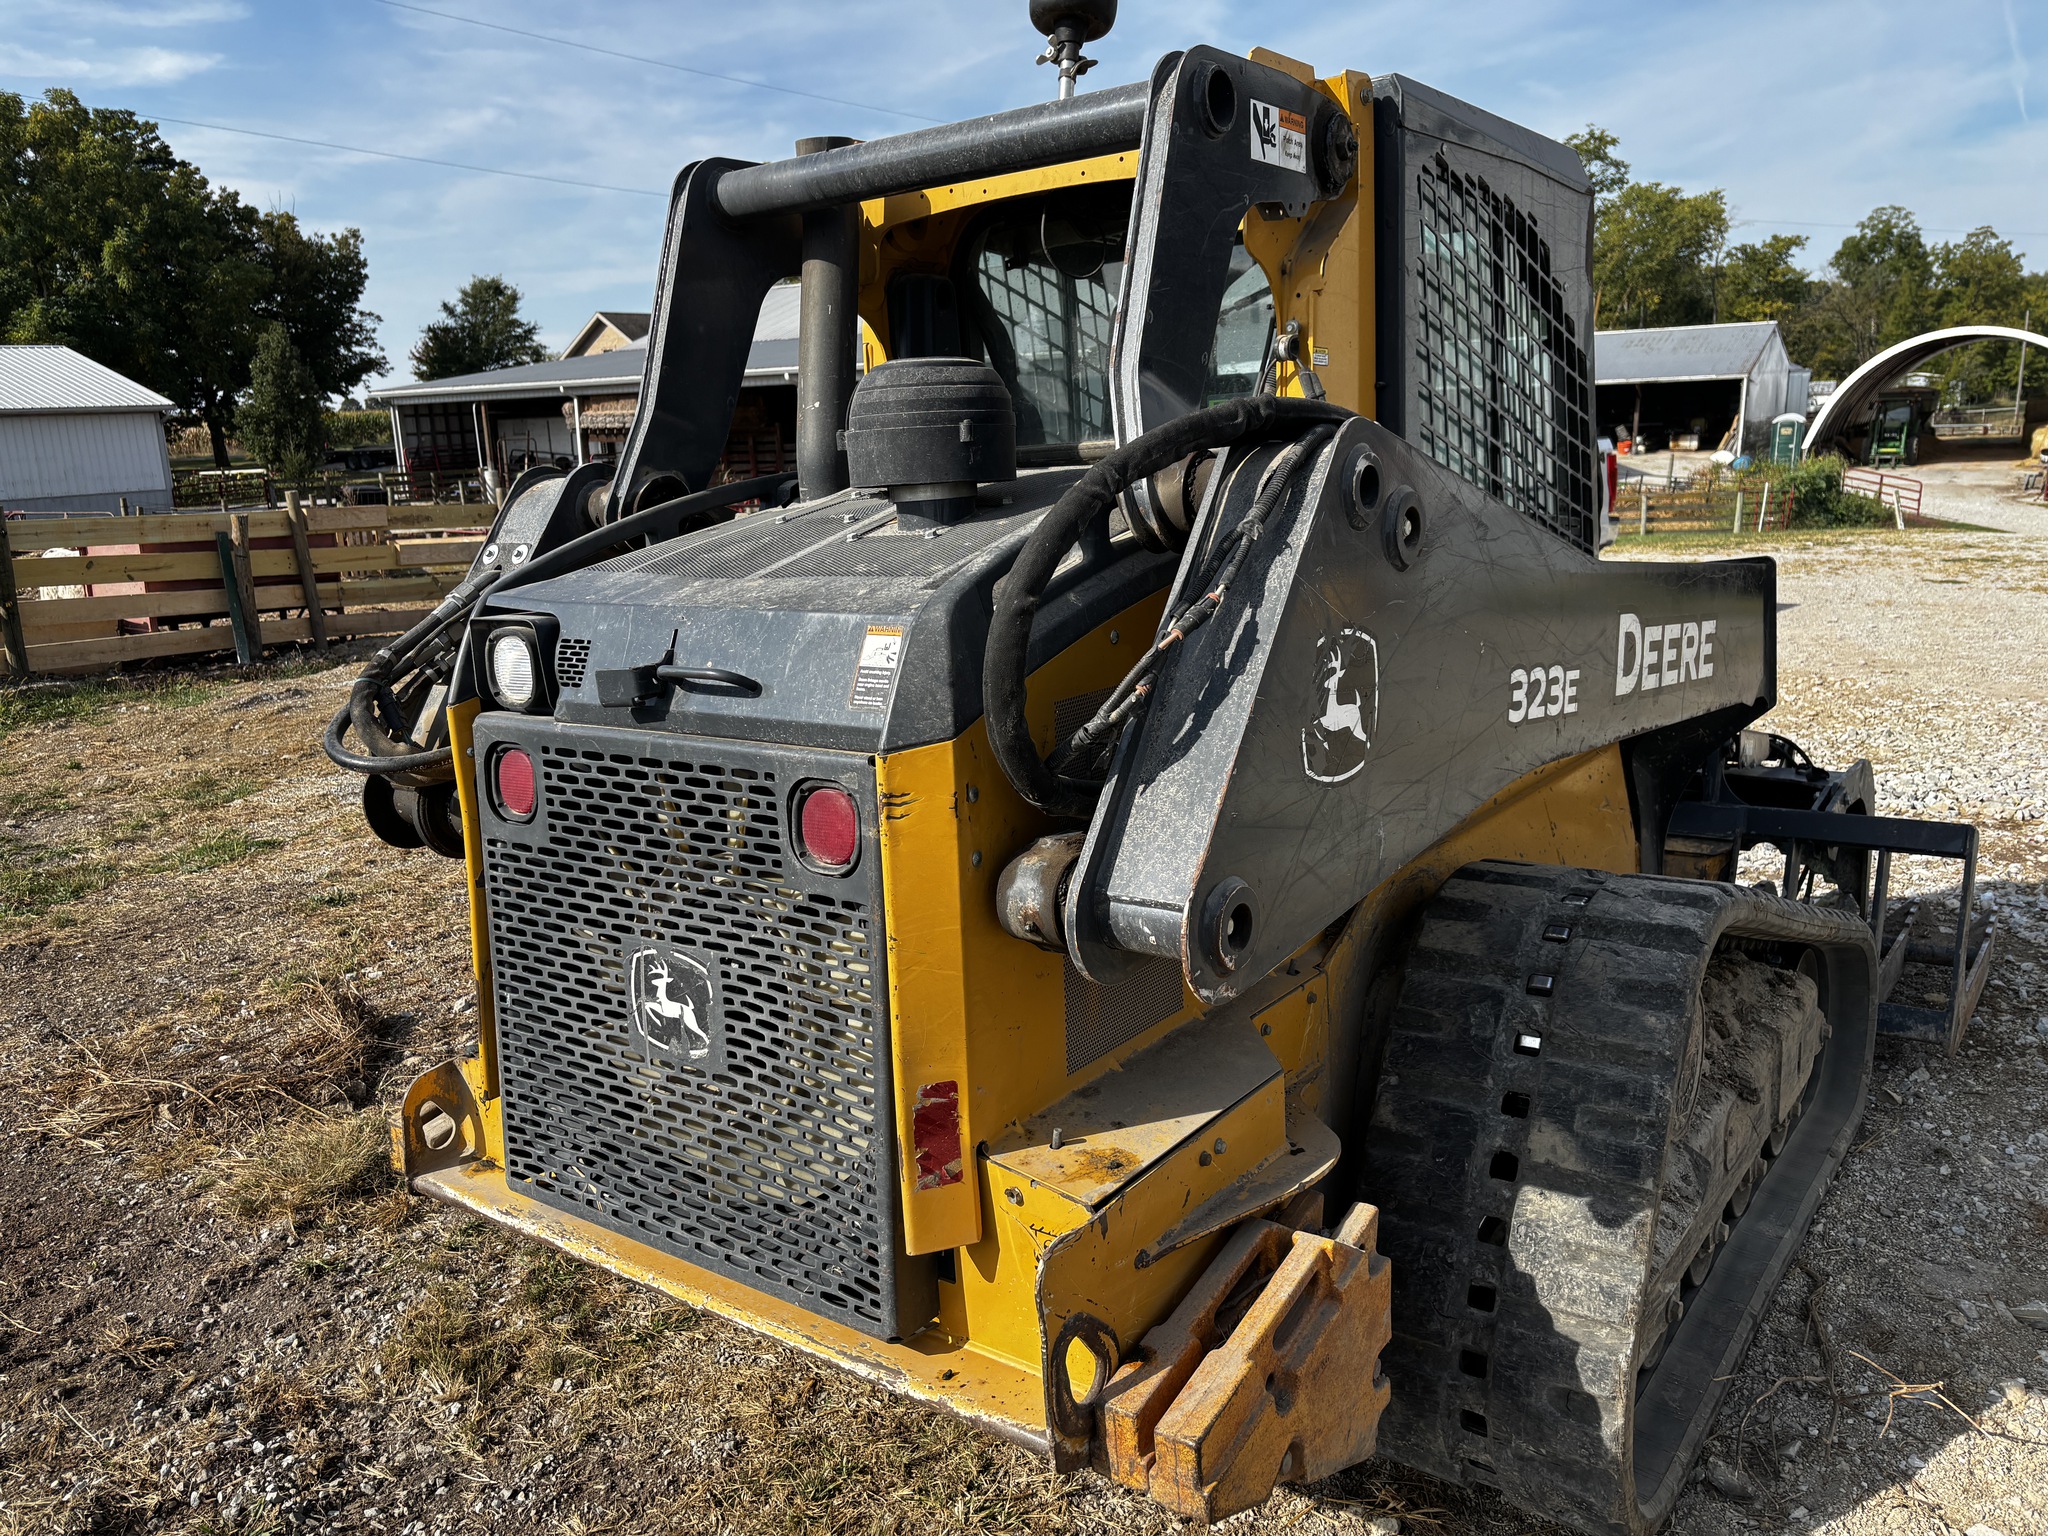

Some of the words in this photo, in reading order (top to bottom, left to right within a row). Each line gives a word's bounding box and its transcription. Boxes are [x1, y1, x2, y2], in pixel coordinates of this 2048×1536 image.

[1285, 117, 1304, 129] WARNING
[1615, 613, 1717, 697] DEERE
[1508, 664, 1580, 723] 323E
